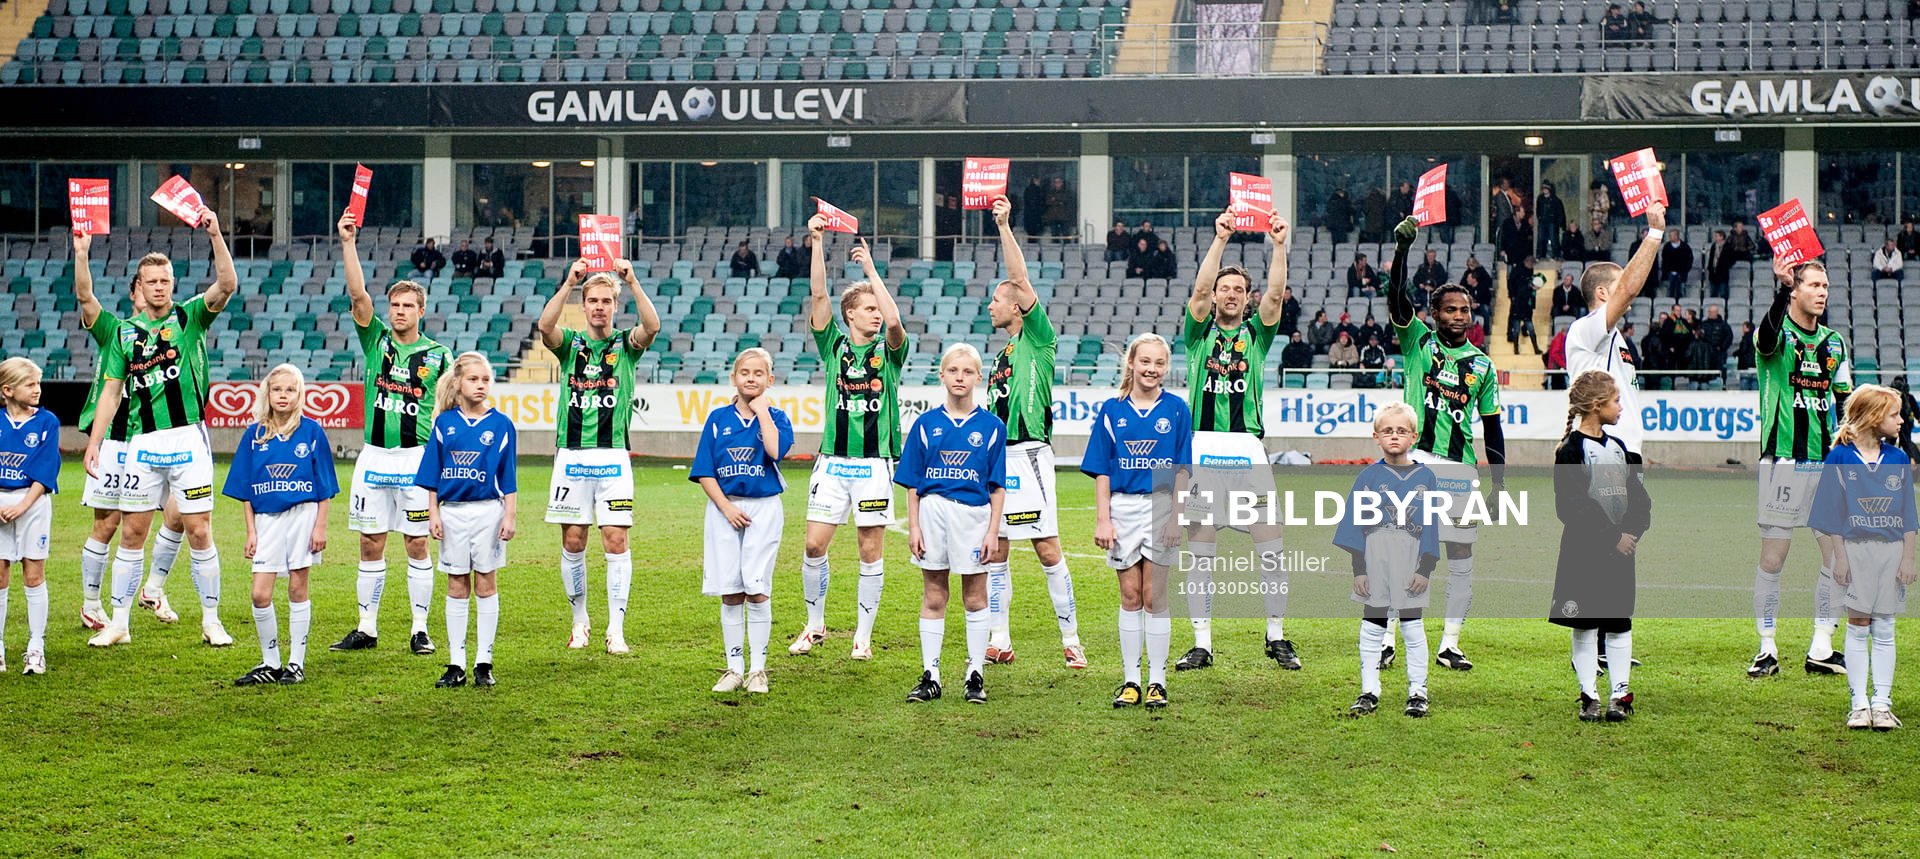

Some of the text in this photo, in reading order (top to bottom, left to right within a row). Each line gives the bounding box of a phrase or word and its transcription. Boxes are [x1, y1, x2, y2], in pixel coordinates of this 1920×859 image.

[1691, 79, 1861, 114] GAMLA
[528, 88, 864, 122] GAMLA ULLEVI
[1202, 376, 1247, 394] ÅBRO
[568, 392, 617, 409] ÅBRO
[836, 394, 881, 411] ÅBRO
[228, 418, 254, 427] GLAC
[1641, 400, 1760, 439] eborgs-
[104, 474, 120, 489] 23
[123, 474, 139, 490] 22
[926, 467, 980, 483] RELLEBOR
[252, 481, 312, 496] TRELLEBORG
[555, 486, 570, 502] 17
[1777, 486, 1791, 502] 15
